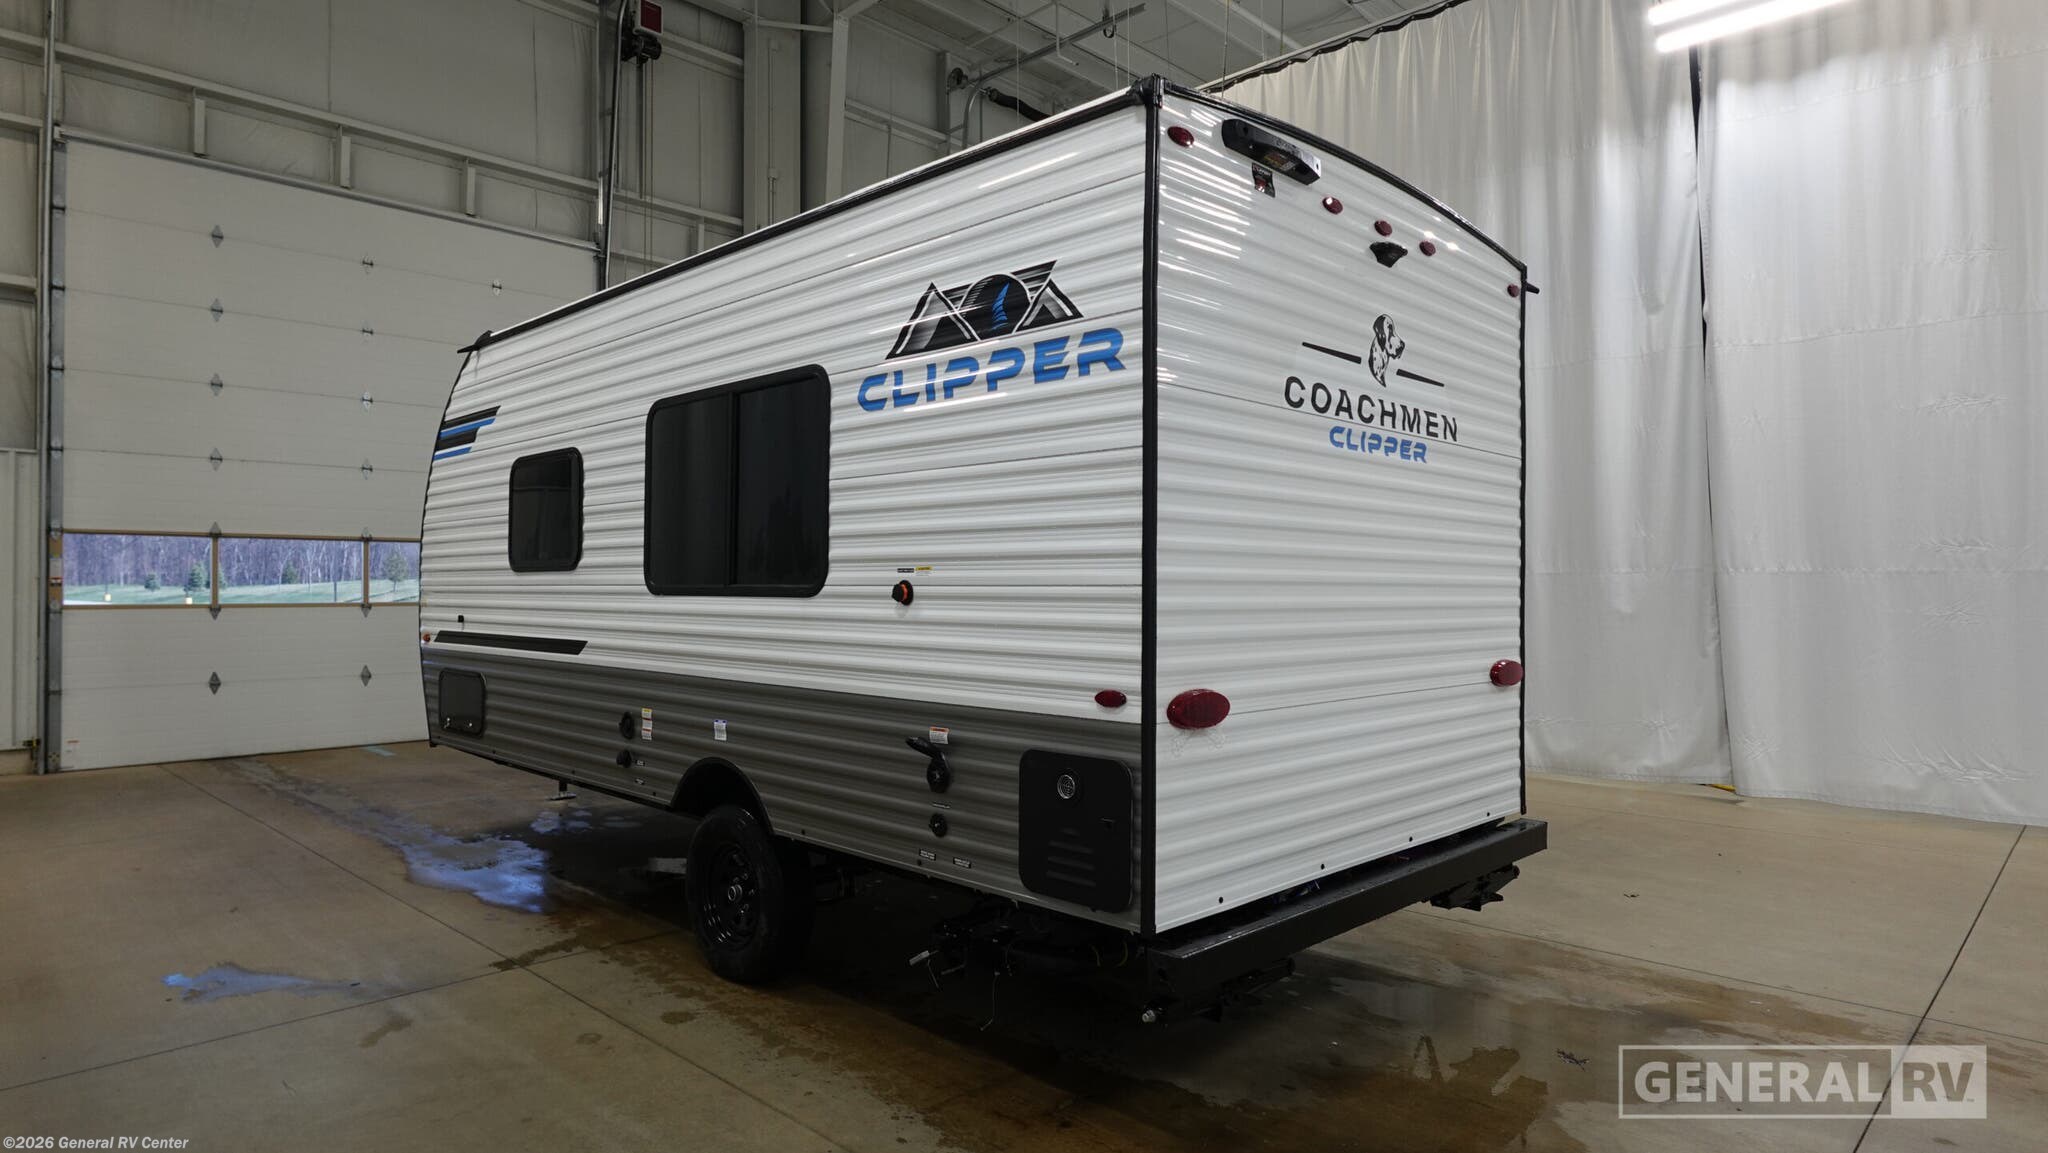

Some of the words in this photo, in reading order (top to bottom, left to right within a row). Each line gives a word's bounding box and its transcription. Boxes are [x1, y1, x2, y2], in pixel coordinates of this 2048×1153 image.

[857, 327, 1127, 412] CLIPPER
[1284, 376, 1458, 442] COACHMEN
[1329, 425, 1428, 464] CLIPPER
